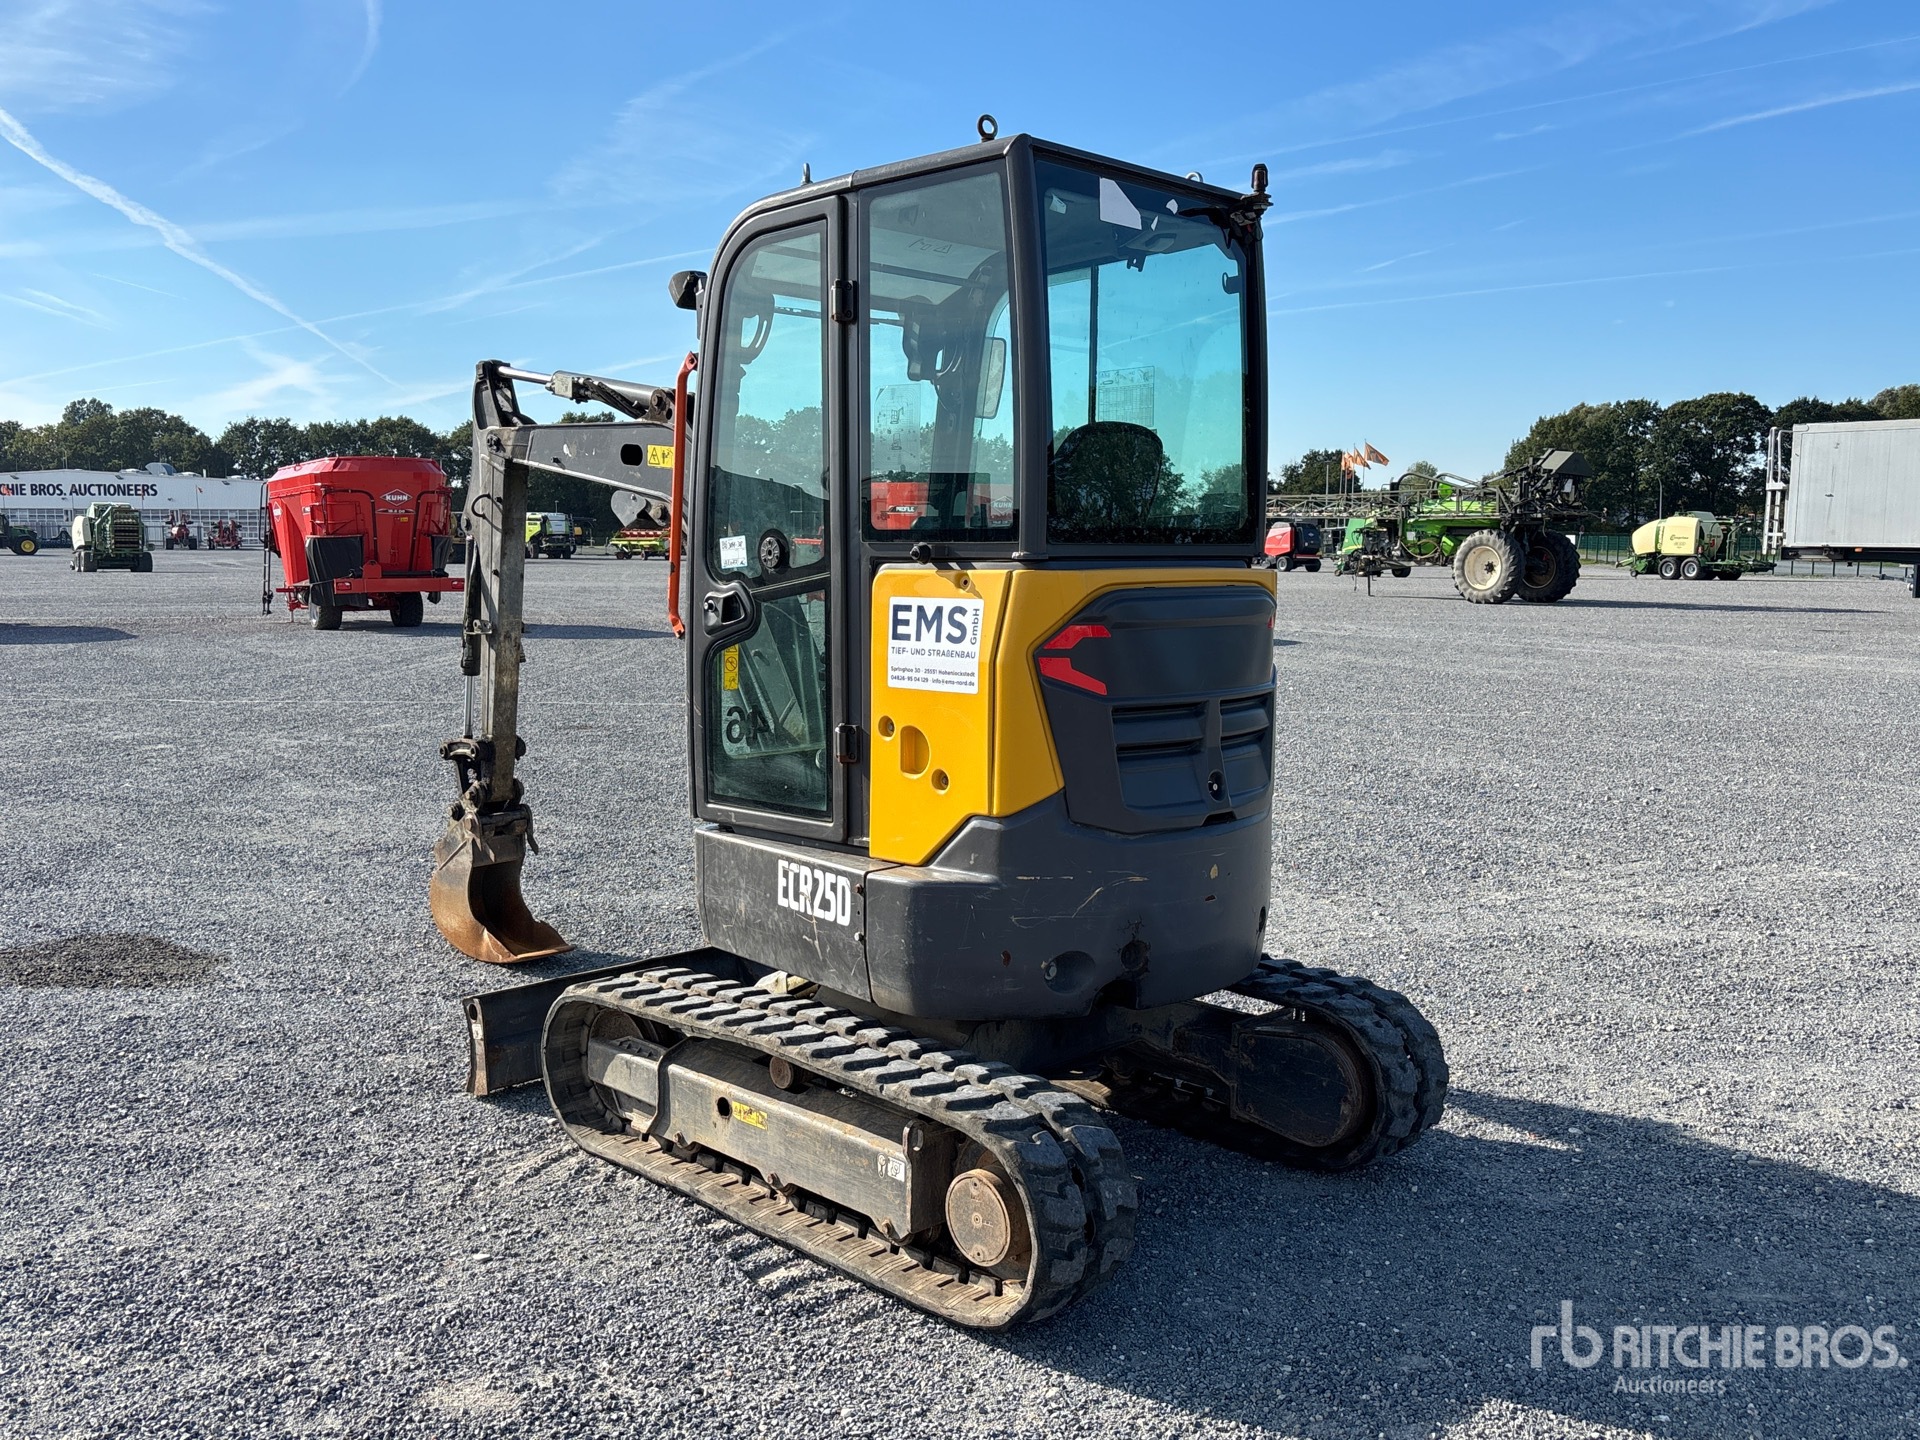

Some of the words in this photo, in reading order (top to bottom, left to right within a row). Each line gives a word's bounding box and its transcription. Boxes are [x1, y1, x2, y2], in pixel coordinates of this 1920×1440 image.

[30, 483, 67, 496] BROS.
[69, 483, 158, 496] AUCTIONEERS
[892, 604, 968, 645] EMS
[970, 608, 980, 645] GmbH
[891, 646, 909, 655] TIEF-
[910, 648, 926, 656] UND
[777, 859, 852, 927] ECR25D
